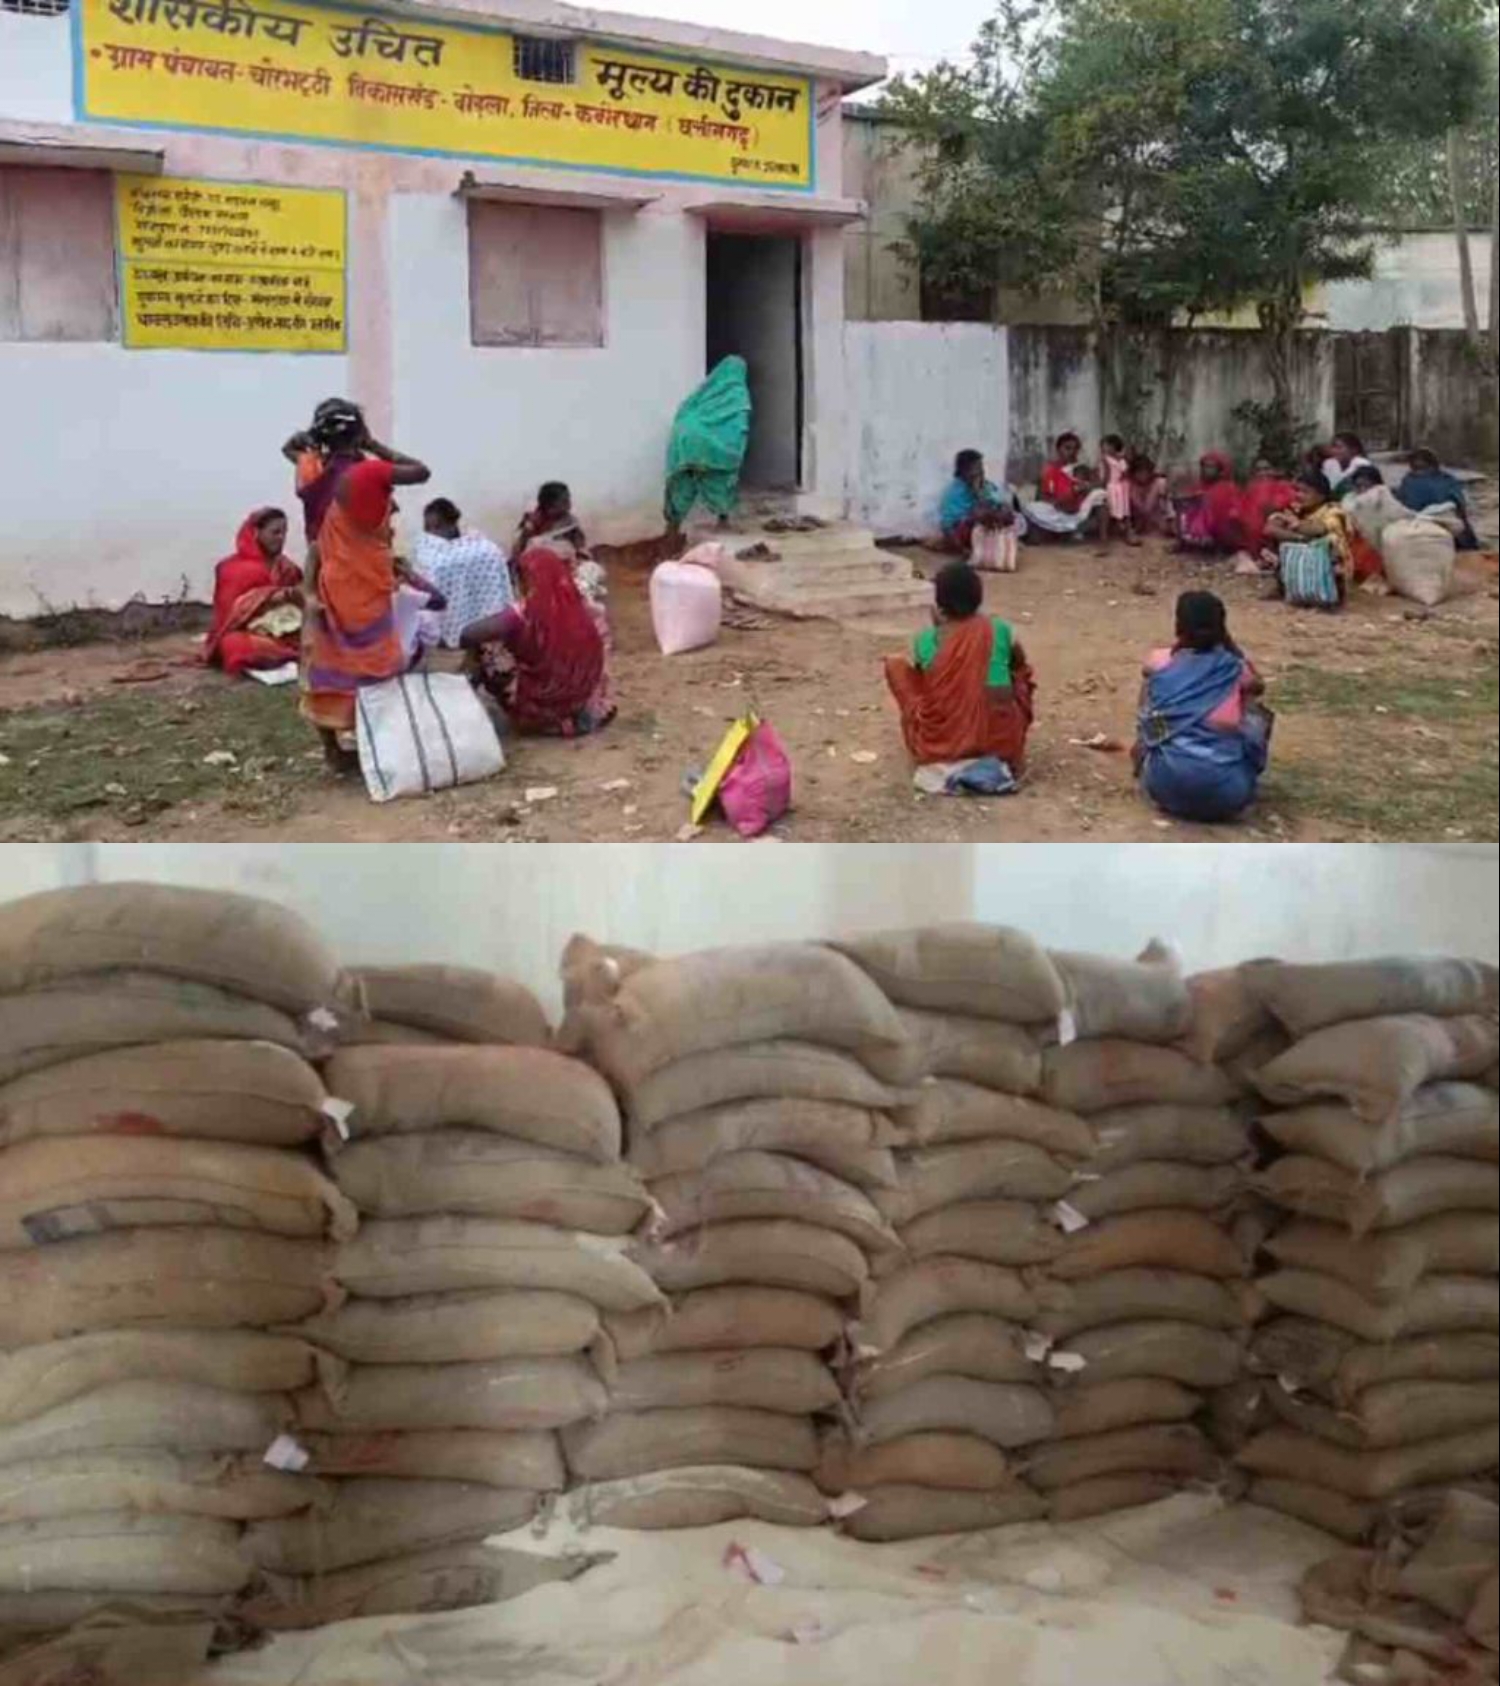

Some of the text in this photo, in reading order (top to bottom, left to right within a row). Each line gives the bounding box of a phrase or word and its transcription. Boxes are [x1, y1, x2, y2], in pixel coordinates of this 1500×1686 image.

[103, 44, 156, 70] ग्राम
[328, 17, 445, 67] उचित
[591, 58, 681, 100] मूल्य
[682, 65, 722, 104] की
[721, 79, 801, 121] दुकान
